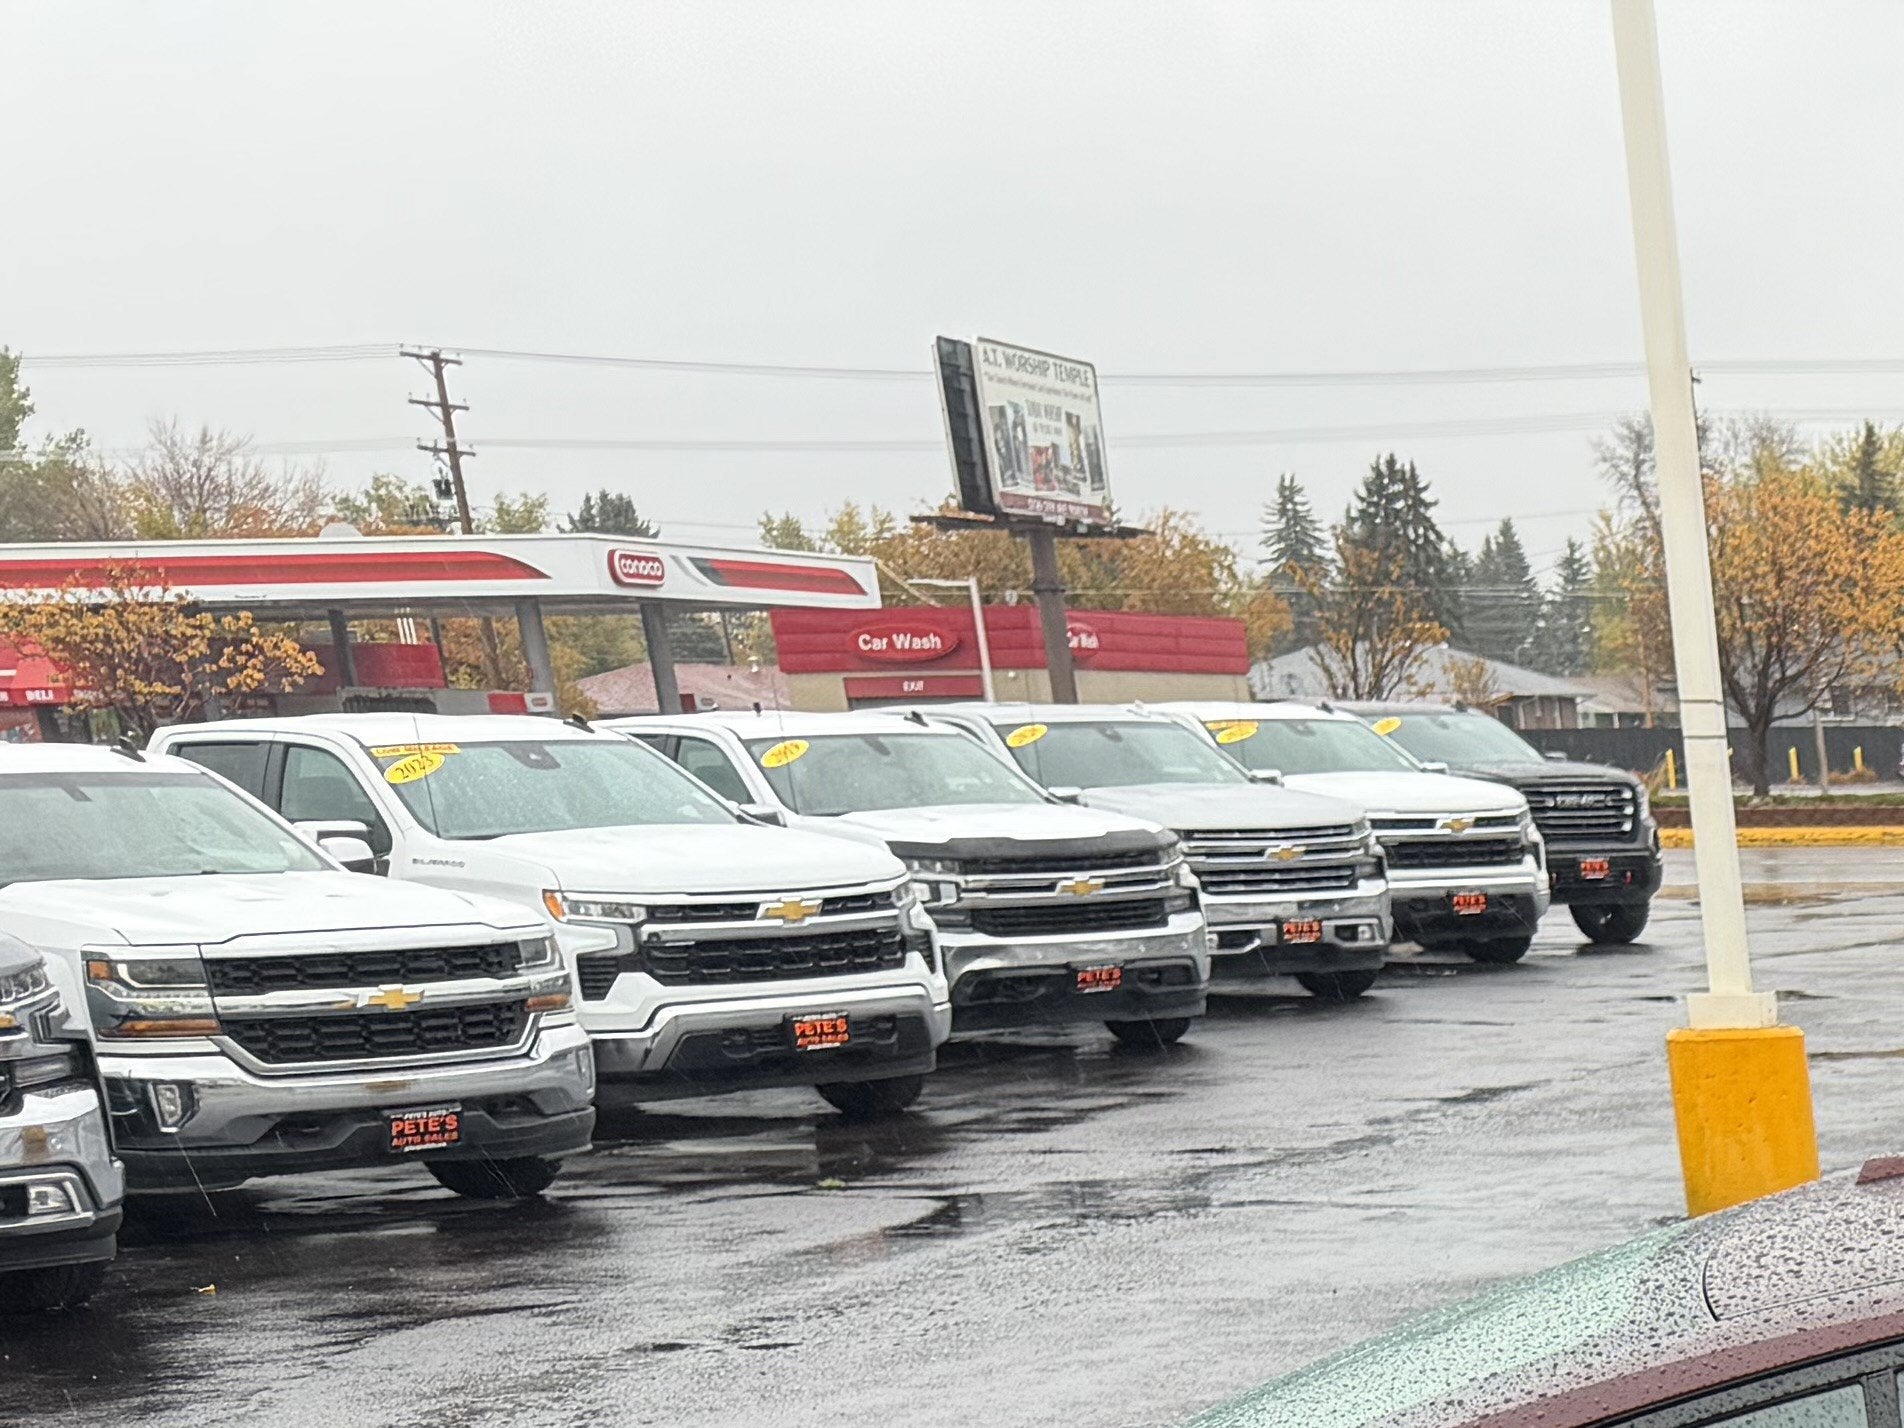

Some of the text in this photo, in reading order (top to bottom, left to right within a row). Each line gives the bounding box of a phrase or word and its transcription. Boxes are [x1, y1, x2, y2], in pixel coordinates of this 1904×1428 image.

[858, 632, 942, 650] Car Wash
[391, 1114, 458, 1136] PETE'S
